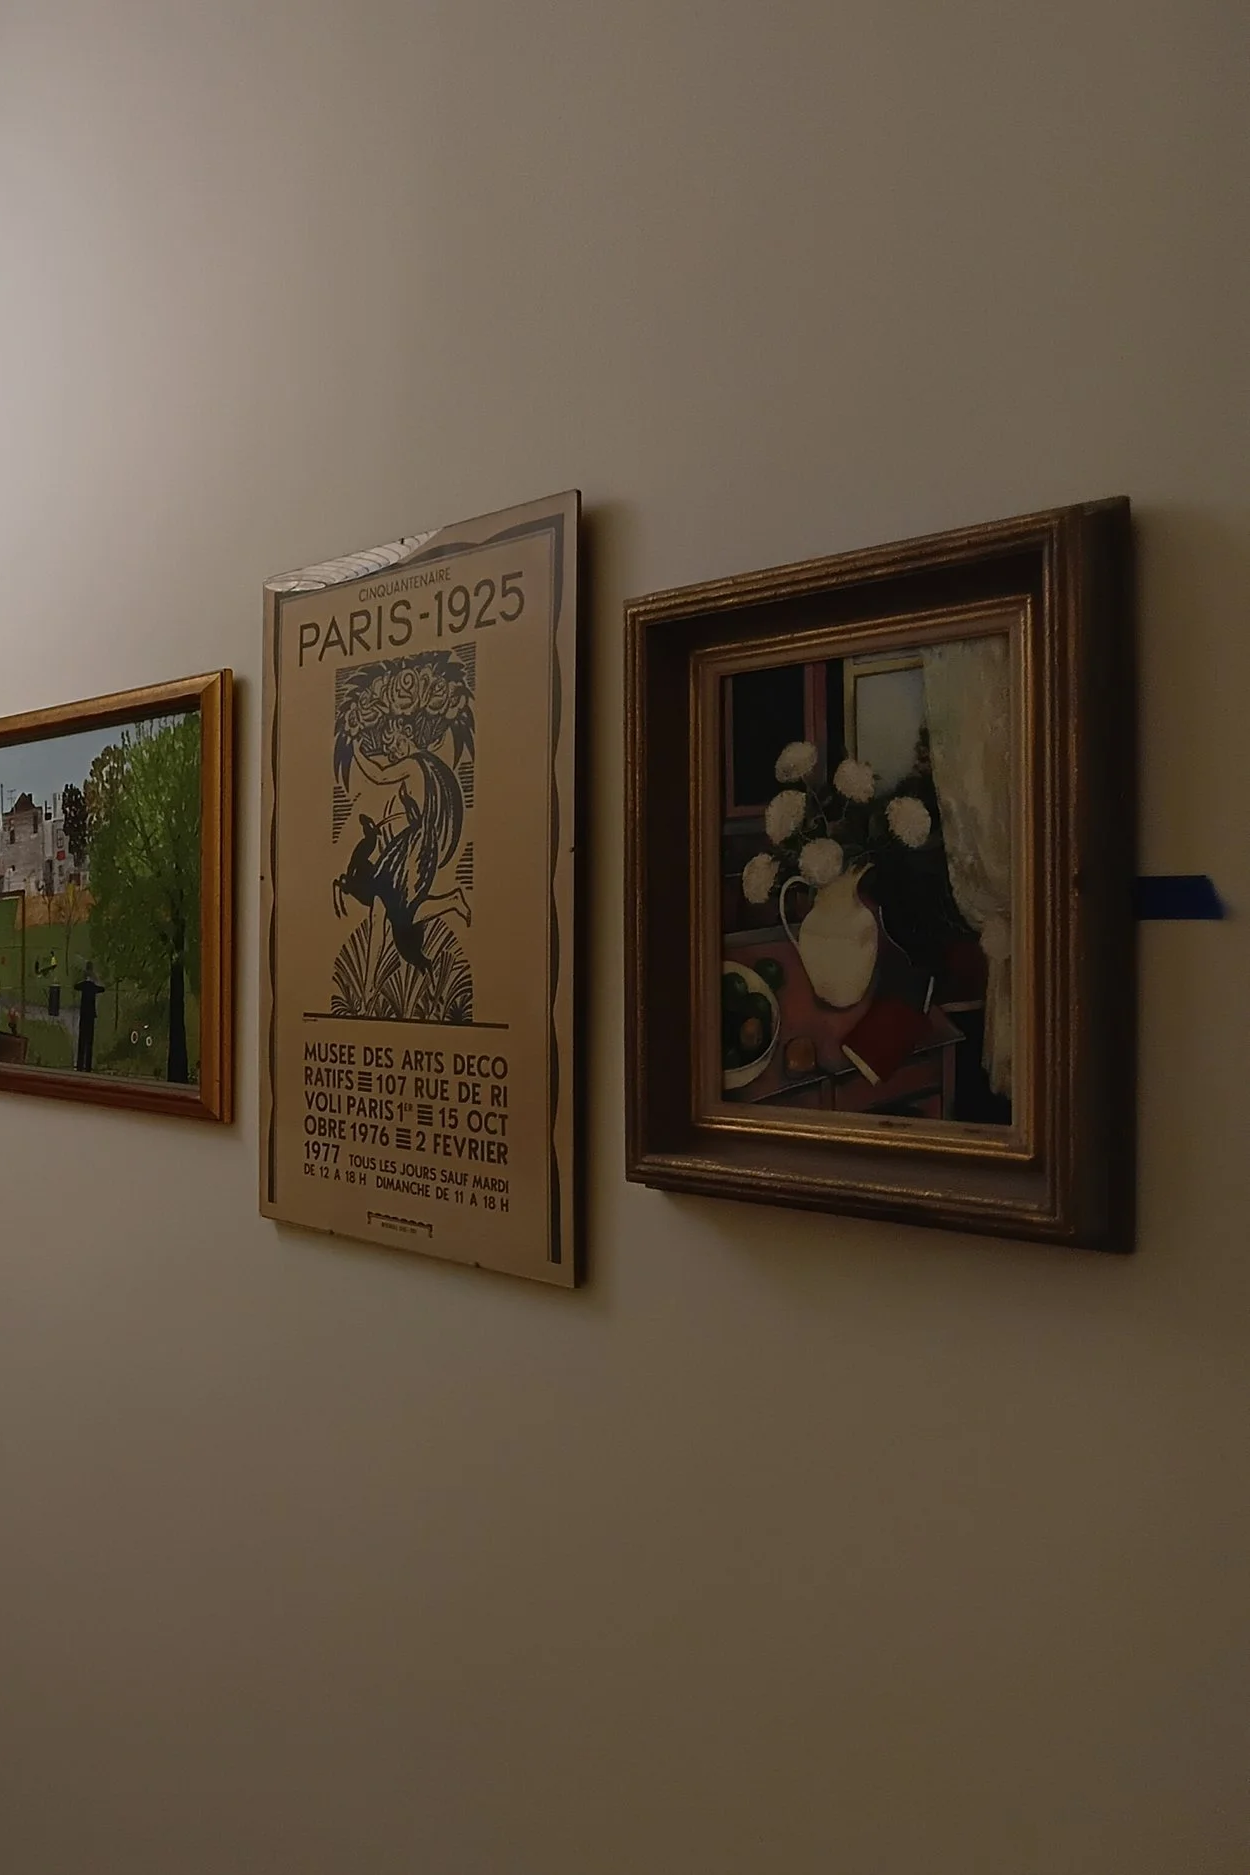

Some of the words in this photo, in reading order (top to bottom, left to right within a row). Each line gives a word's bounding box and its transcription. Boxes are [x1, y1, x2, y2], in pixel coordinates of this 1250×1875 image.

[359, 567, 451, 602] CINQUANTENAIRE
[299, 572, 524, 667] PARIS-1925
[305, 1042, 355, 1066] MUSEE
[363, 1047, 394, 1068] DES
[401, 1051, 444, 1074] ARTS
[454, 1053, 508, 1079] DECO
[305, 1068, 354, 1090] RATIFS
[377, 1075, 406, 1096] 107
[415, 1077, 449, 1101] RUE
[458, 1083, 481, 1105] DE
[491, 1085, 508, 1107] RI
[305, 1092, 341, 1114] VOLI
[347, 1098, 394, 1121] PARIS
[439, 1107, 458, 1129] 15
[467, 1110, 508, 1136] OCT
[304, 1115, 346, 1139] OBRE
[350, 1122, 389, 1146] 1976
[416, 1131, 426, 1152] 2
[433, 1134, 508, 1165] FEVRIER
[304, 1142, 340, 1163] 1977
[349, 1154, 376, 1170] TOUS
[379, 1159, 397, 1174] LES
[400, 1163, 436, 1180] JOURS
[440, 1169, 468, 1186] SAUF
[472, 1175, 509, 1194] MARDI
[304, 1163, 315, 1176] DE
[319, 1166, 329, 1179] 12
[334, 1167, 341, 1180] A
[345, 1170, 356, 1183] 18
[359, 1172, 366, 1185] H
[376, 1175, 430, 1197] DIMANCHE
[436, 1186, 449, 1201] DE
[455, 1189, 463, 1204] 11
[470, 1192, 477, 1207] A
[483, 1195, 496, 1209] 18
[500, 1198, 509, 1212] H
